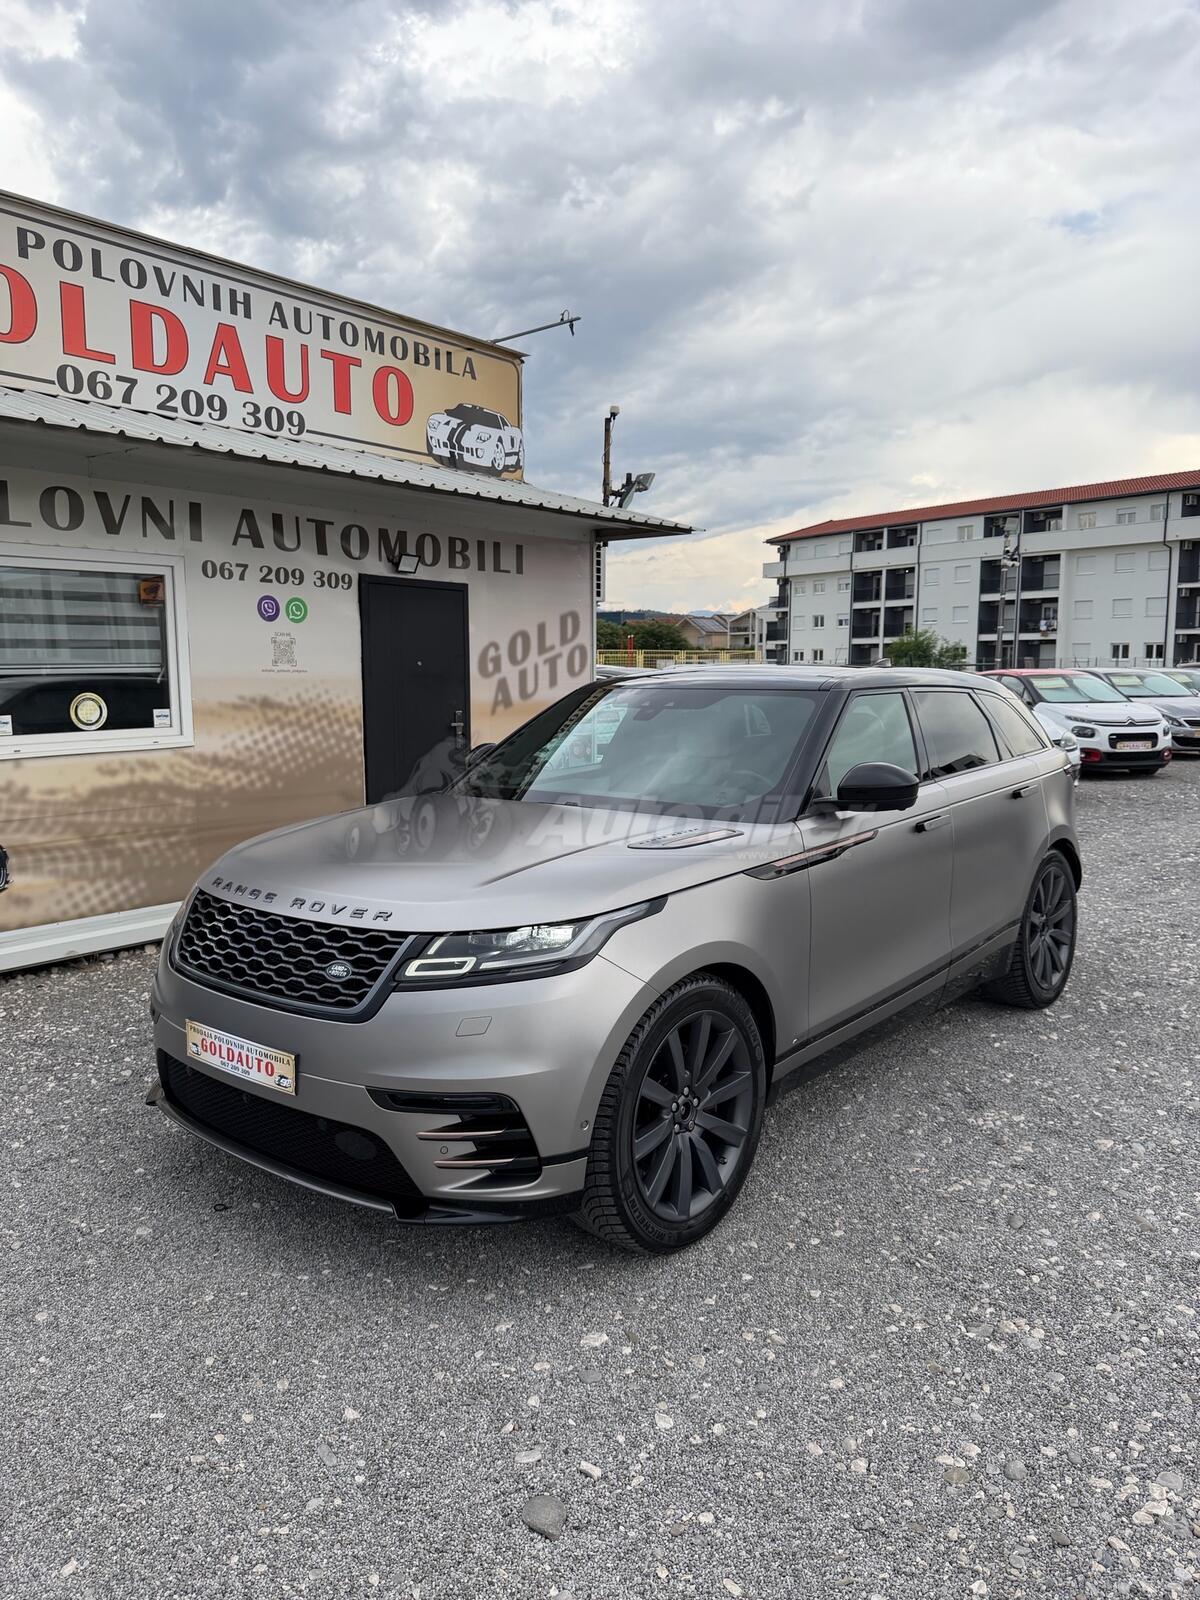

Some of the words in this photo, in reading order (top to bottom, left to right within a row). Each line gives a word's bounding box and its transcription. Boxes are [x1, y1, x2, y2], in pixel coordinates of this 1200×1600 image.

[17, 226, 252, 320] POLOVNIH
[268, 301, 477, 381] AUTOMOBILA
[56, 364, 138, 405] 067
[156, 384, 228, 421] 209
[242, 401, 306, 436] 309
[0, 479, 203, 542] LOVNI
[232, 508, 524, 575] AUTOMOBILI
[201, 559, 249, 581] 067
[259, 565, 305, 586] 209
[313, 570, 353, 591] 309
[478, 610, 581, 680] GOLD
[491, 643, 589, 716] AUTO
[211, 877, 277, 904] RANGE
[289, 897, 393, 922] ROVER
[189, 1025, 213, 1040] PRODAJA
[214, 1035, 245, 1051] POLOVNIH
[246, 1046, 291, 1066] AUTOMOBILA
[201, 1038, 275, 1077] GOLDAUTO
